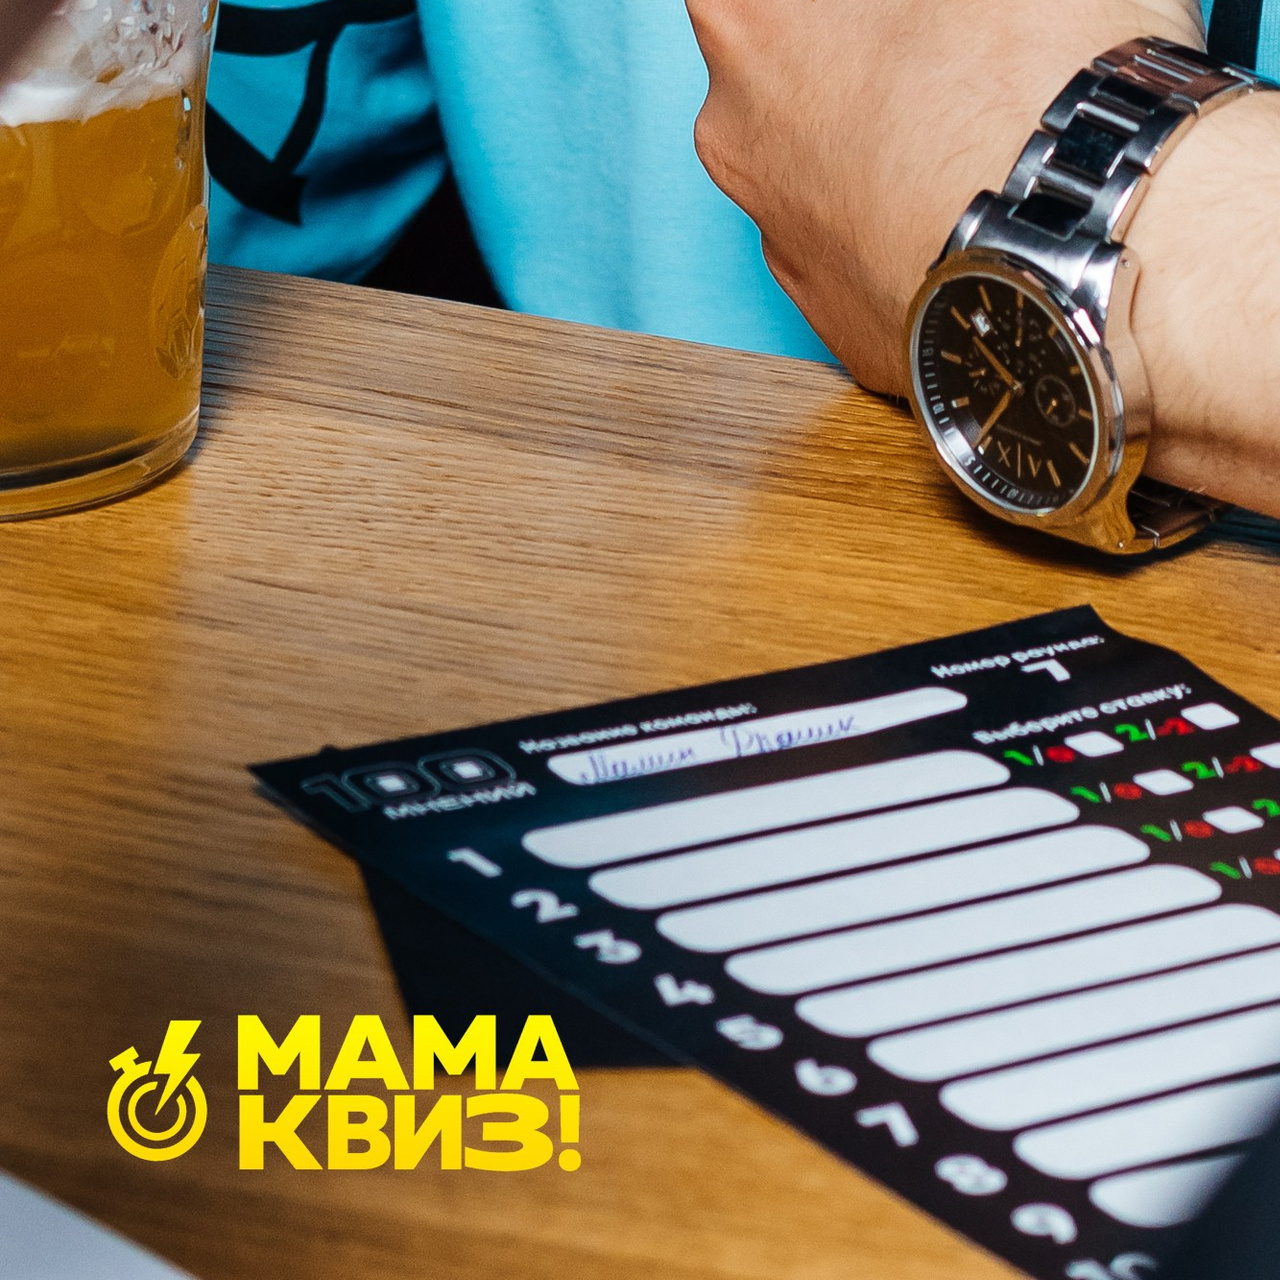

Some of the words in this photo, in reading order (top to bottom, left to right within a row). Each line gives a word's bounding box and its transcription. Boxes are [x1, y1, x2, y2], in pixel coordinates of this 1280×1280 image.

[448, 847, 502, 878] 1
[511, 888, 579, 923] 2
[573, 929, 643, 965] 3
[653, 973, 716, 1007] 4
[715, 1014, 784, 1051] 5
[794, 1058, 858, 1097] 6
[855, 1101, 920, 1148] 7
[933, 1152, 1009, 1197] 8
[1009, 1202, 1079, 1245] 9
